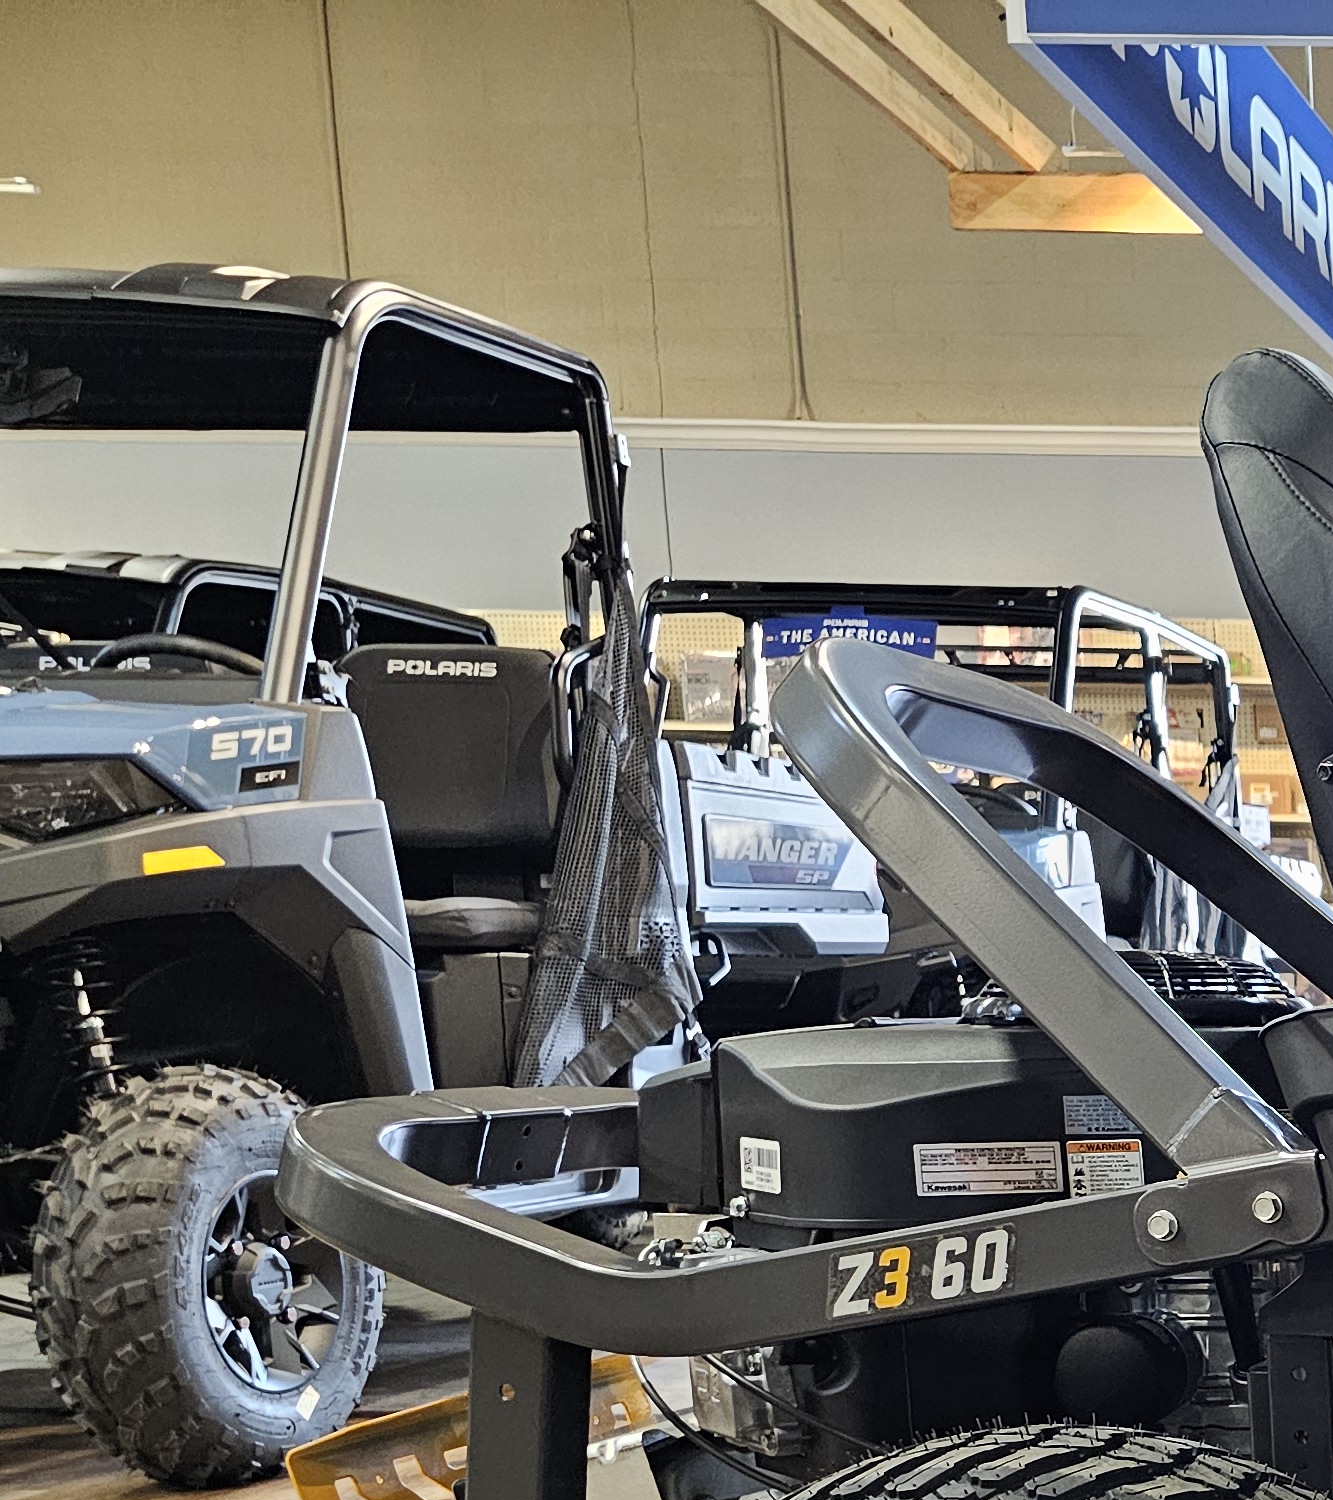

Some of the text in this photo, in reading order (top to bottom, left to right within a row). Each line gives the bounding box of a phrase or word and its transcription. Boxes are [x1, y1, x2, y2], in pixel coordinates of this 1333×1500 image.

[780, 627, 916, 647] THE AMERICAN
[387, 658, 498, 678] POLARIS
[210, 724, 293, 761] 570
[795, 869, 830, 885] SP
[1085, 1142, 1132, 1152] WARNING
[832, 1229, 1009, 1318] Z3 60
